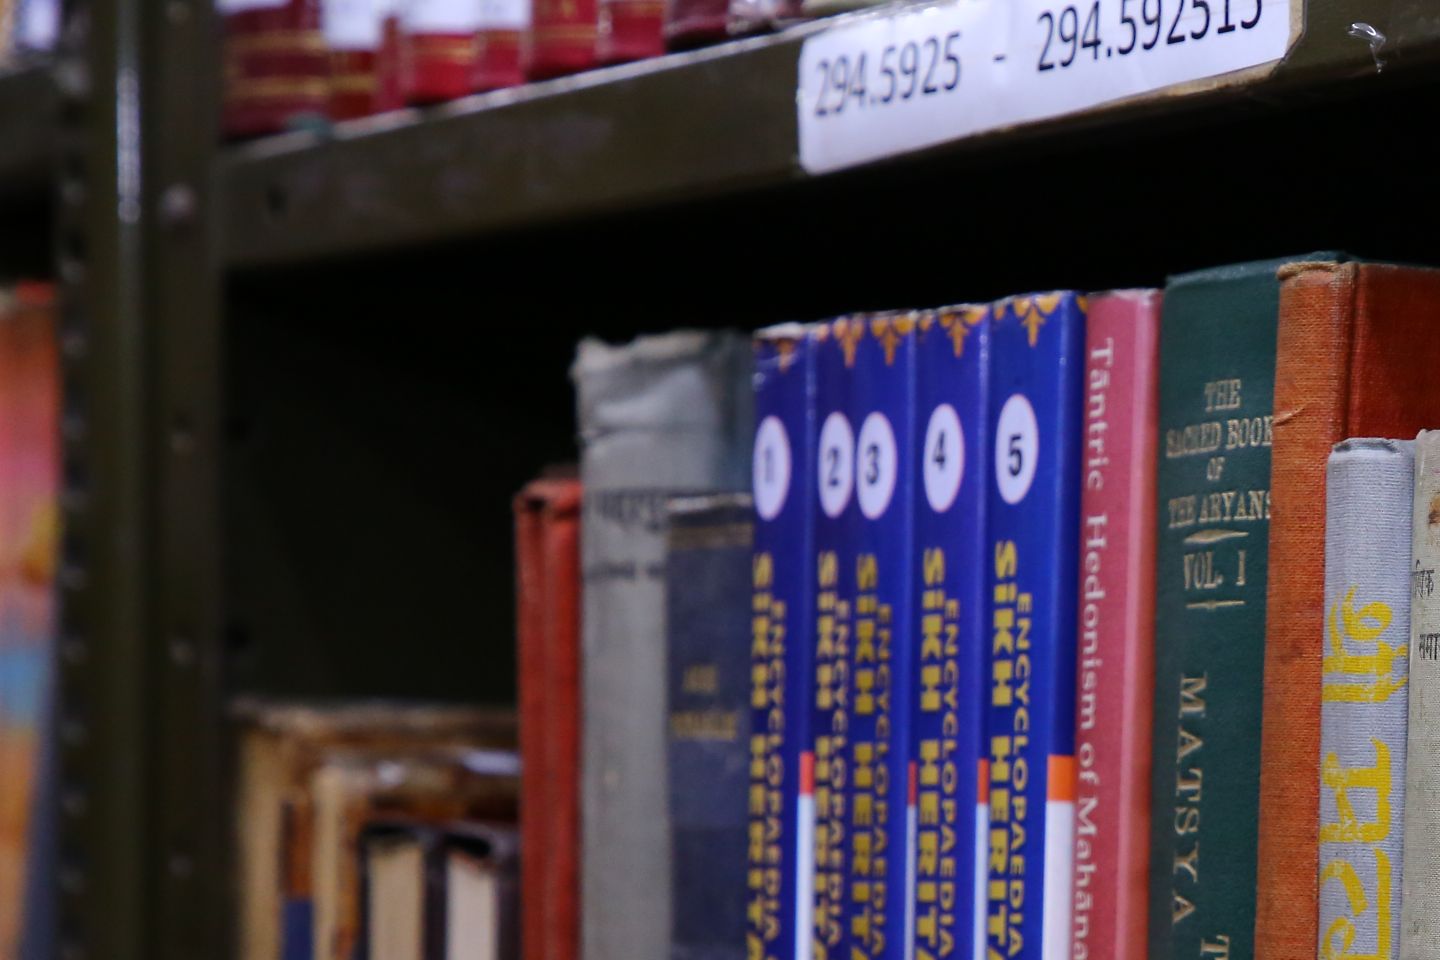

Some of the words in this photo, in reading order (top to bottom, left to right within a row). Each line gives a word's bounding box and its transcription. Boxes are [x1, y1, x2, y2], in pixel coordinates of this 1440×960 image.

[813, 31, 962, 117] 294.5925
[1087, 337, 1114, 491] Tāntric
[1204, 378, 1242, 412] THE
[931, 430, 947, 468] 4
[1008, 435, 1023, 477] 5
[1166, 421, 1222, 458] SACRED
[763, 441, 777, 484] 1
[826, 447, 841, 487] 2
[865, 446, 881, 486] 3
[1207, 457, 1225, 481] OF
[1184, 551, 1223, 589] VOL.
[1083, 512, 1108, 731] Hedonism
[938, 599, 958, 956] ENCYCLOPAEDIA
[1008, 593, 1031, 956] ENCYCLOPAEDIA
[1080, 741, 1100, 786] of
[1171, 673, 1208, 924] MATSYA
